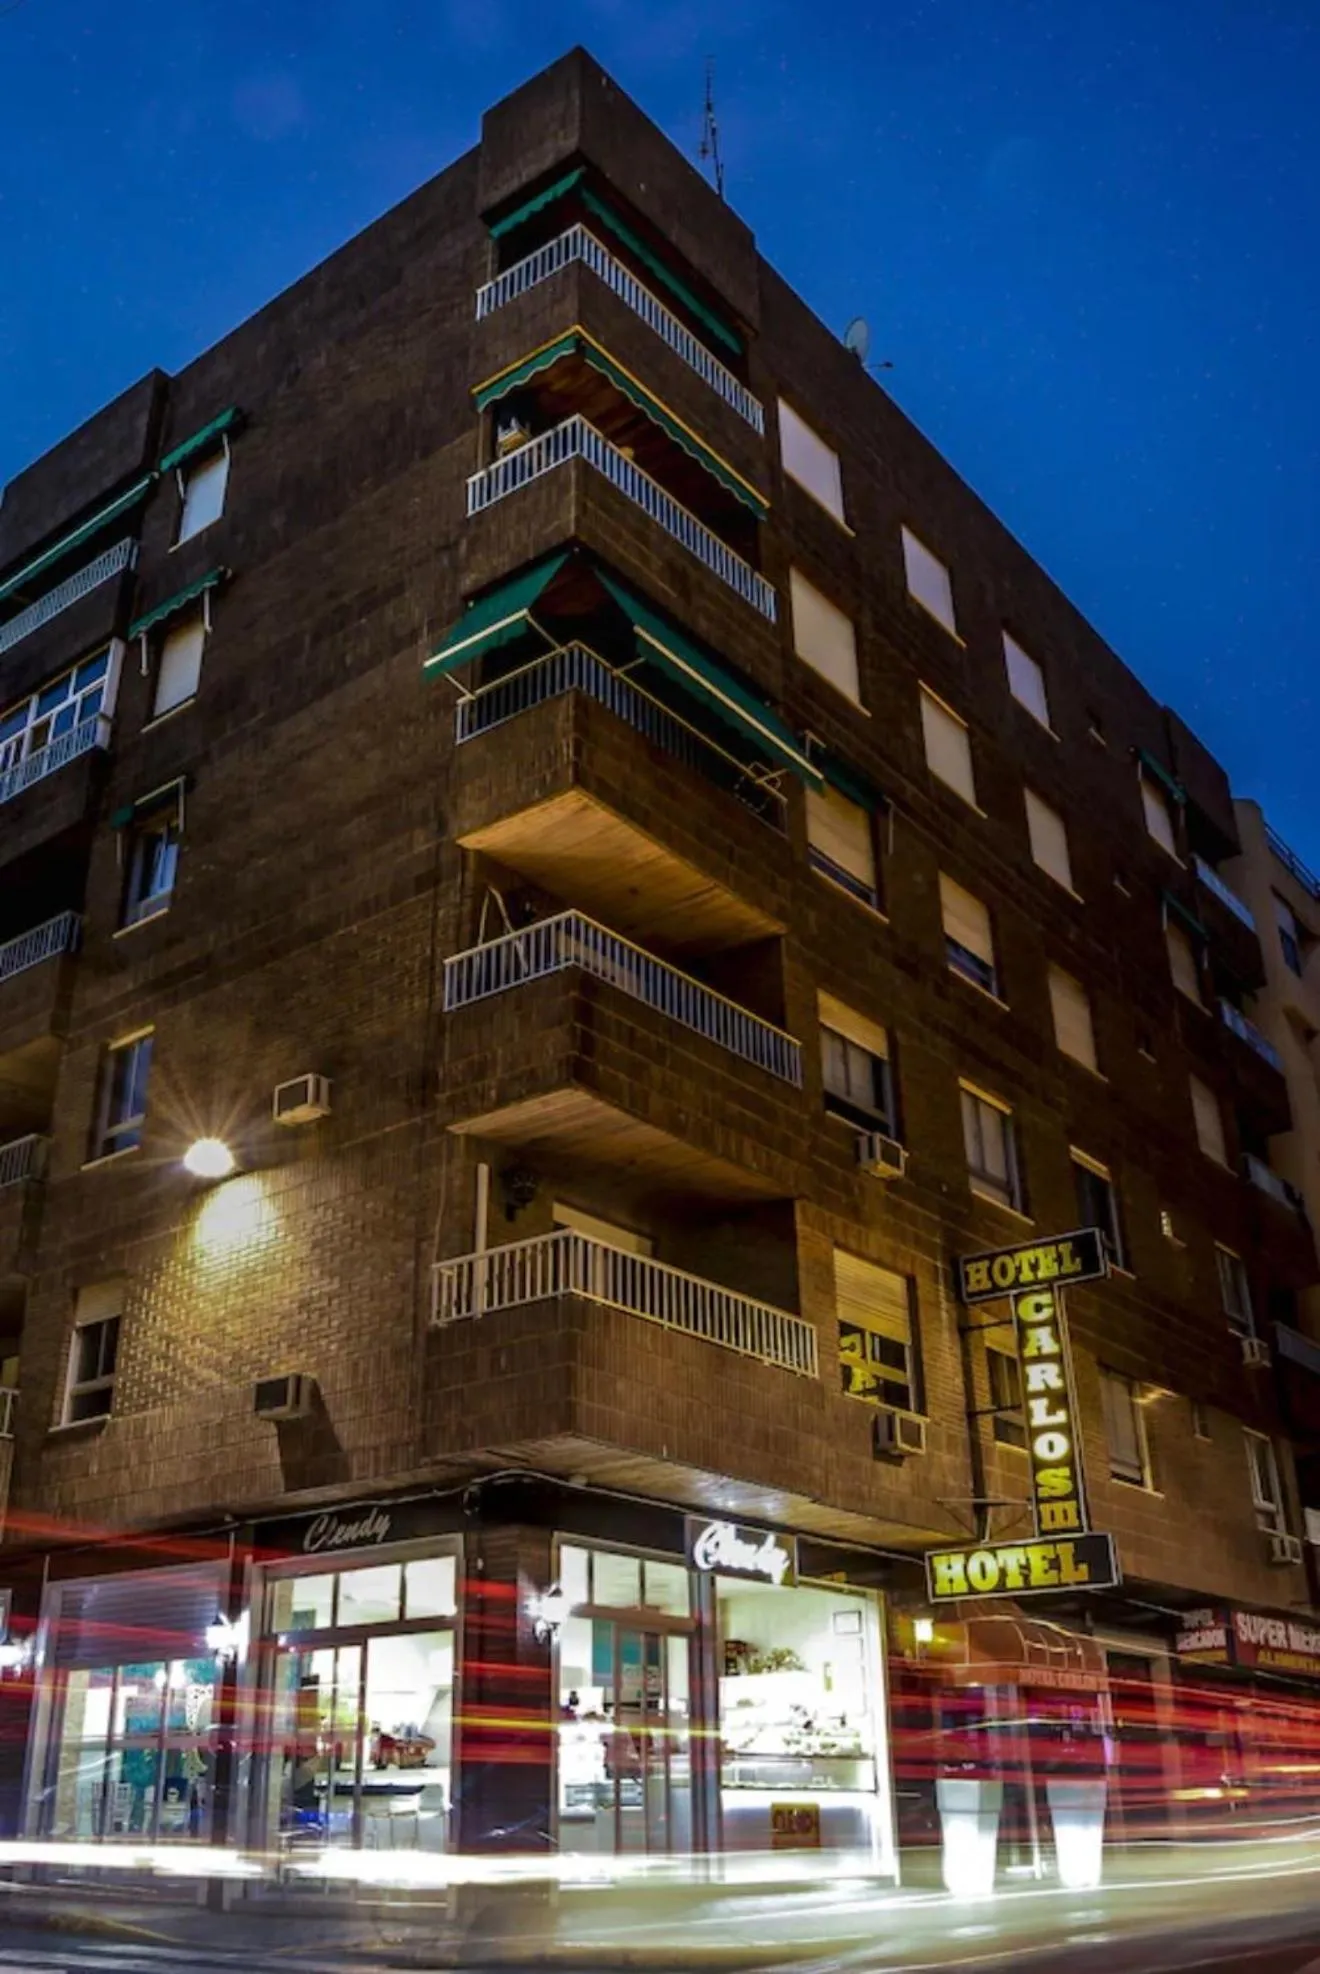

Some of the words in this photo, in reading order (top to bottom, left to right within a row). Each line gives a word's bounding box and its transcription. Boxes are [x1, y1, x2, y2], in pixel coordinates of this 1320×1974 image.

[966, 1242, 1082, 1292] HOTEL
[1014, 1291, 1073, 1498] CARLOS
[932, 1542, 1089, 1596] HOTEL
[1236, 1611, 1289, 1649] SUPER
